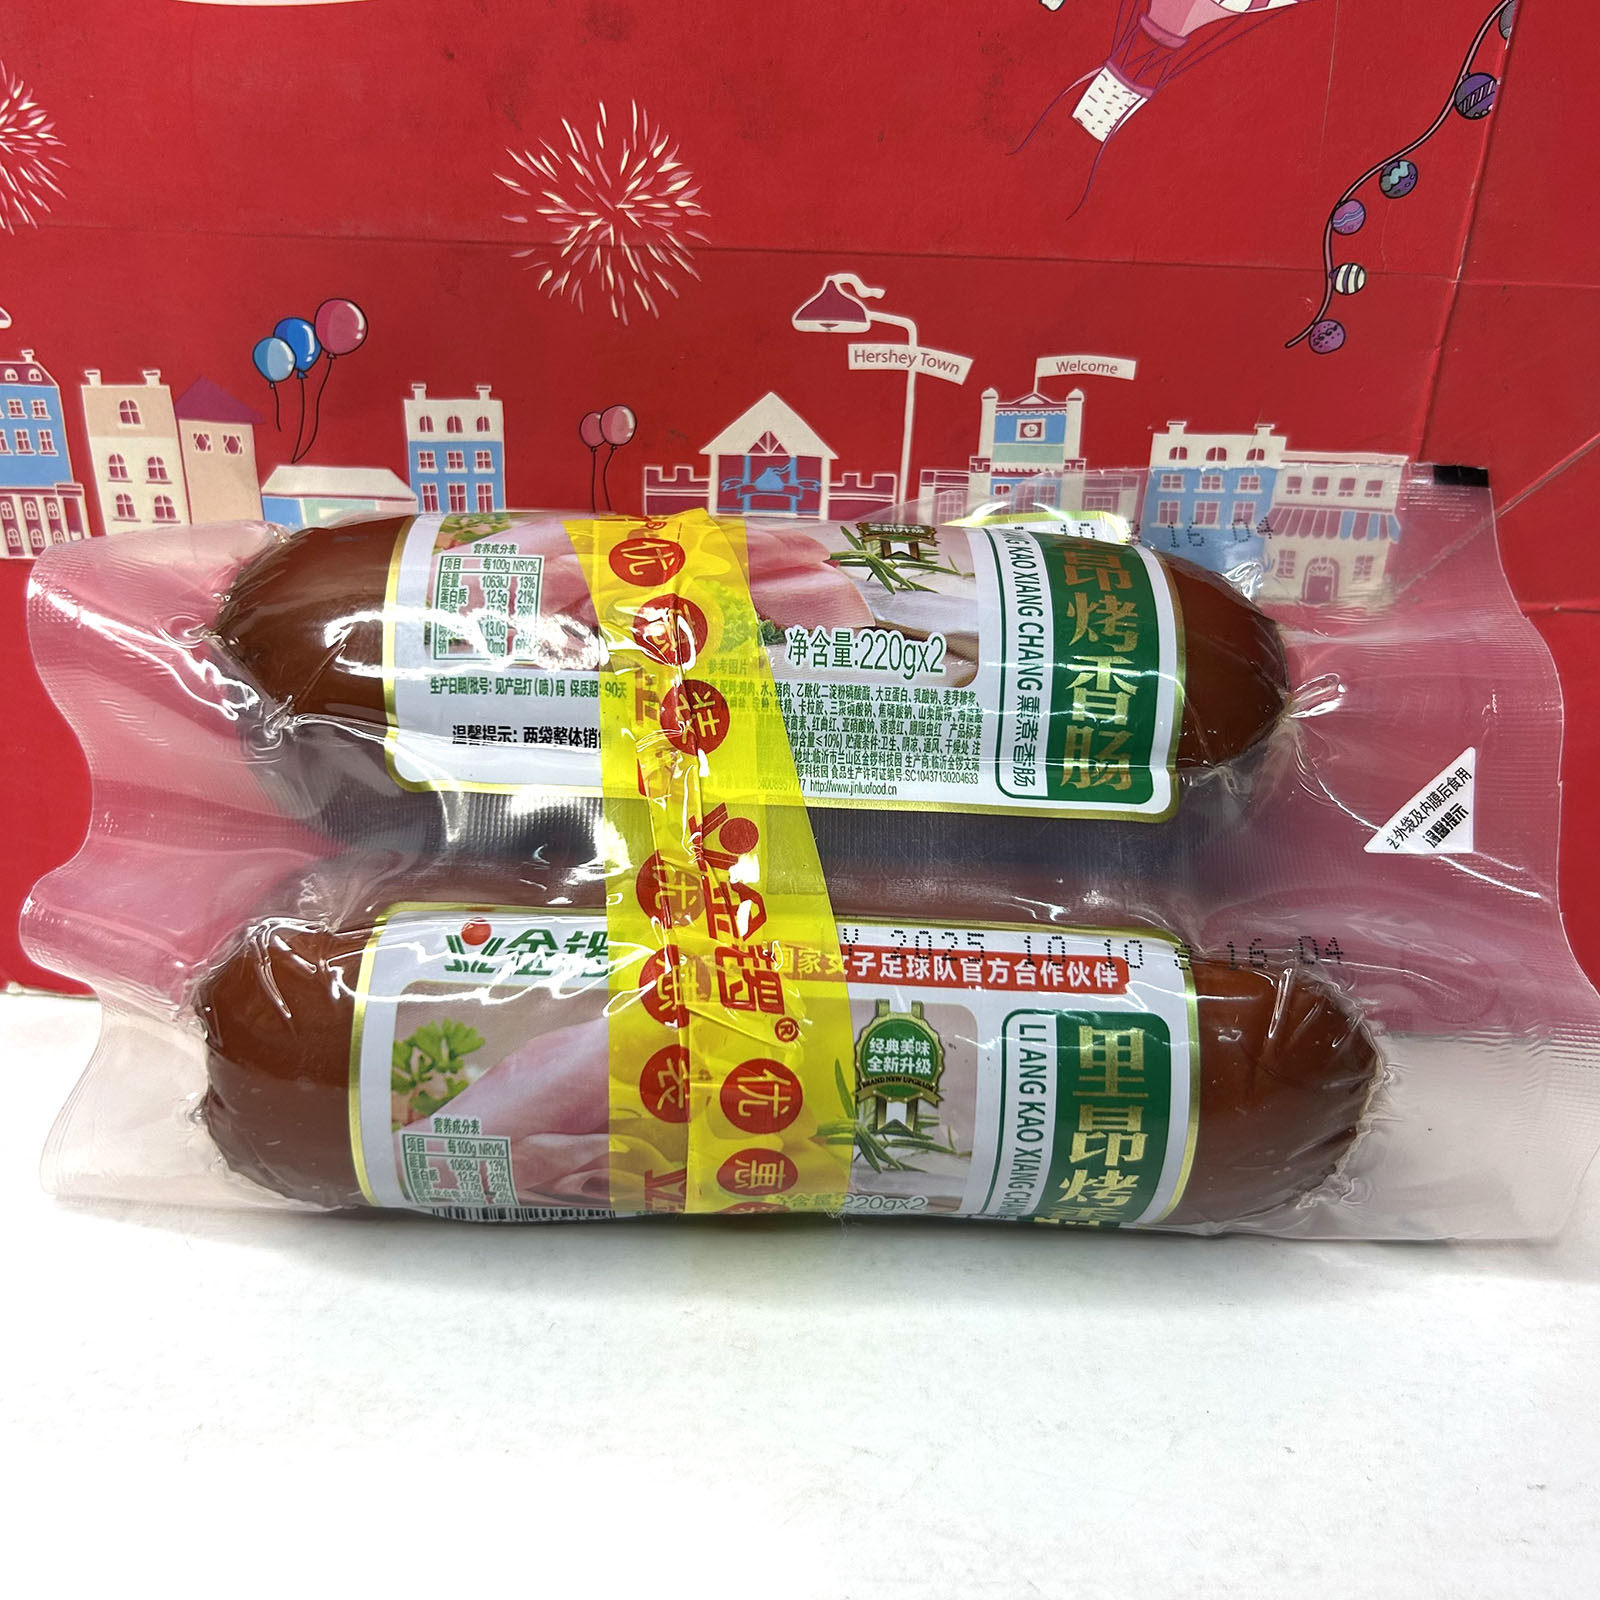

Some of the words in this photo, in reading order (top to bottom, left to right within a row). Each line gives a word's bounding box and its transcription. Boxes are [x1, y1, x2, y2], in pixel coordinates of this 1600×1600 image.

[853, 349, 918, 368] Hershey
[920, 352, 961, 375] Town
[1055, 360, 1119, 375] Welcome
[1167, 521, 1205, 548] 16
[473, 543, 517, 555] 营养成分表
[1007, 546, 1037, 569] KAO
[444, 557, 462, 571] 项目
[483, 558, 511, 573] 每100g
[512, 560, 537, 573] NRV%
[520, 576, 536, 589] 13%
[1012, 571, 1044, 617] XIANG
[517, 589, 535, 604] 21%
[1016, 621, 1045, 692] CHANG
[451, 724, 602, 749] 温馨提示:两袋整体销
[1012, 694, 1041, 787] 熏煮香肠
[890, 929, 985, 963] 2025
[1023, 935, 1066, 967] 10
[1104, 938, 1144, 969] 10
[1226, 937, 1269, 971] 16
[1298, 935, 1344, 966] 04
[869, 1036, 931, 1057] 经典美味
[867, 1056, 932, 1076] 全新升级
[861, 1076, 885, 1089] BRAND
[886, 1075, 902, 1084] NEW
[1016, 1100, 1046, 1143] KAO
[478, 1142, 505, 1157] NRV%
[1008, 1146, 1043, 1191] XIANG
